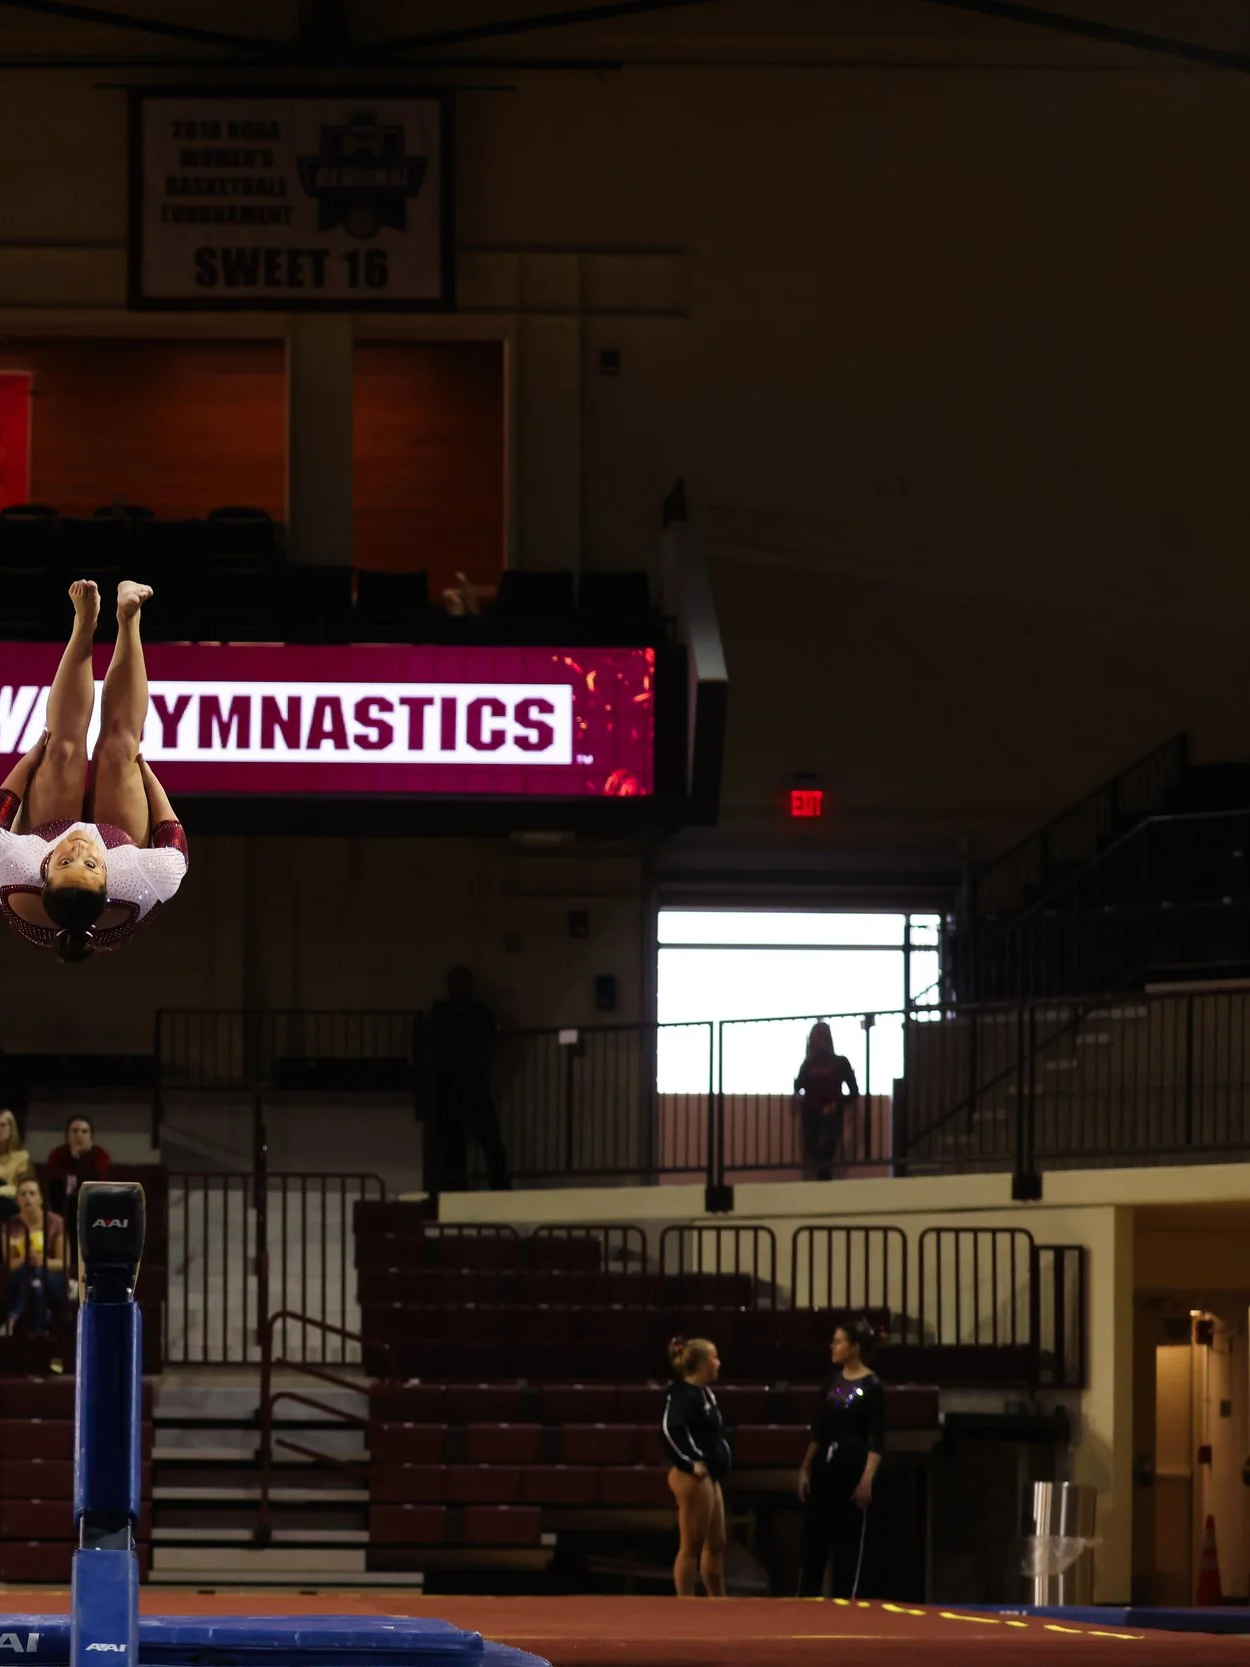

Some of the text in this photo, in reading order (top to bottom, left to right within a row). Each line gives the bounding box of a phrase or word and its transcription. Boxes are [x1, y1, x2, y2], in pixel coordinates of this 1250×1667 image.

[165, 176, 287, 197] BASKETBALL
[160, 204, 294, 225] TOURNAMENT
[194, 247, 388, 289] SWEET 16
[139, 693, 556, 753] YMNASTICS
[791, 789, 823, 817] EXIT
